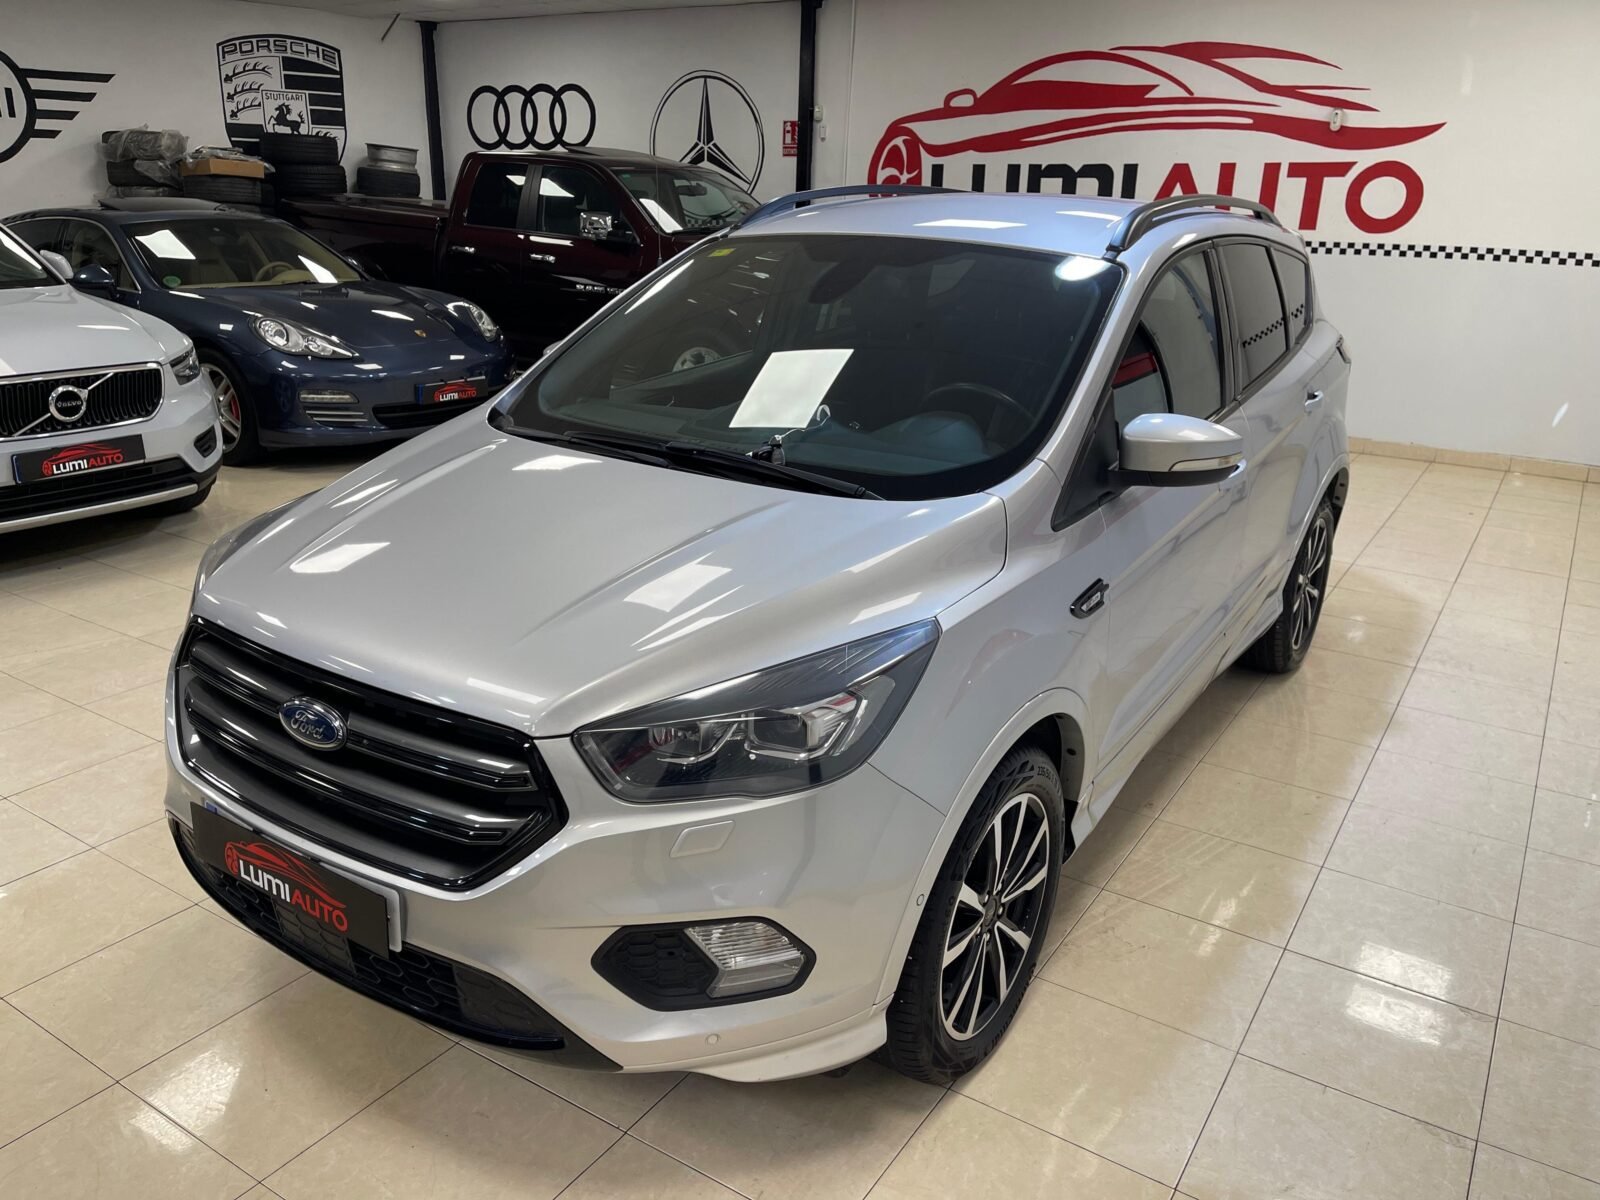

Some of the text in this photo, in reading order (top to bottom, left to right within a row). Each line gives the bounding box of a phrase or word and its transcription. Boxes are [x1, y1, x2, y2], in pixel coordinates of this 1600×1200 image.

[221, 39, 338, 67] PORSCHE
[264, 92, 303, 102] STUTTGART
[290, 709, 325, 740] Ford
